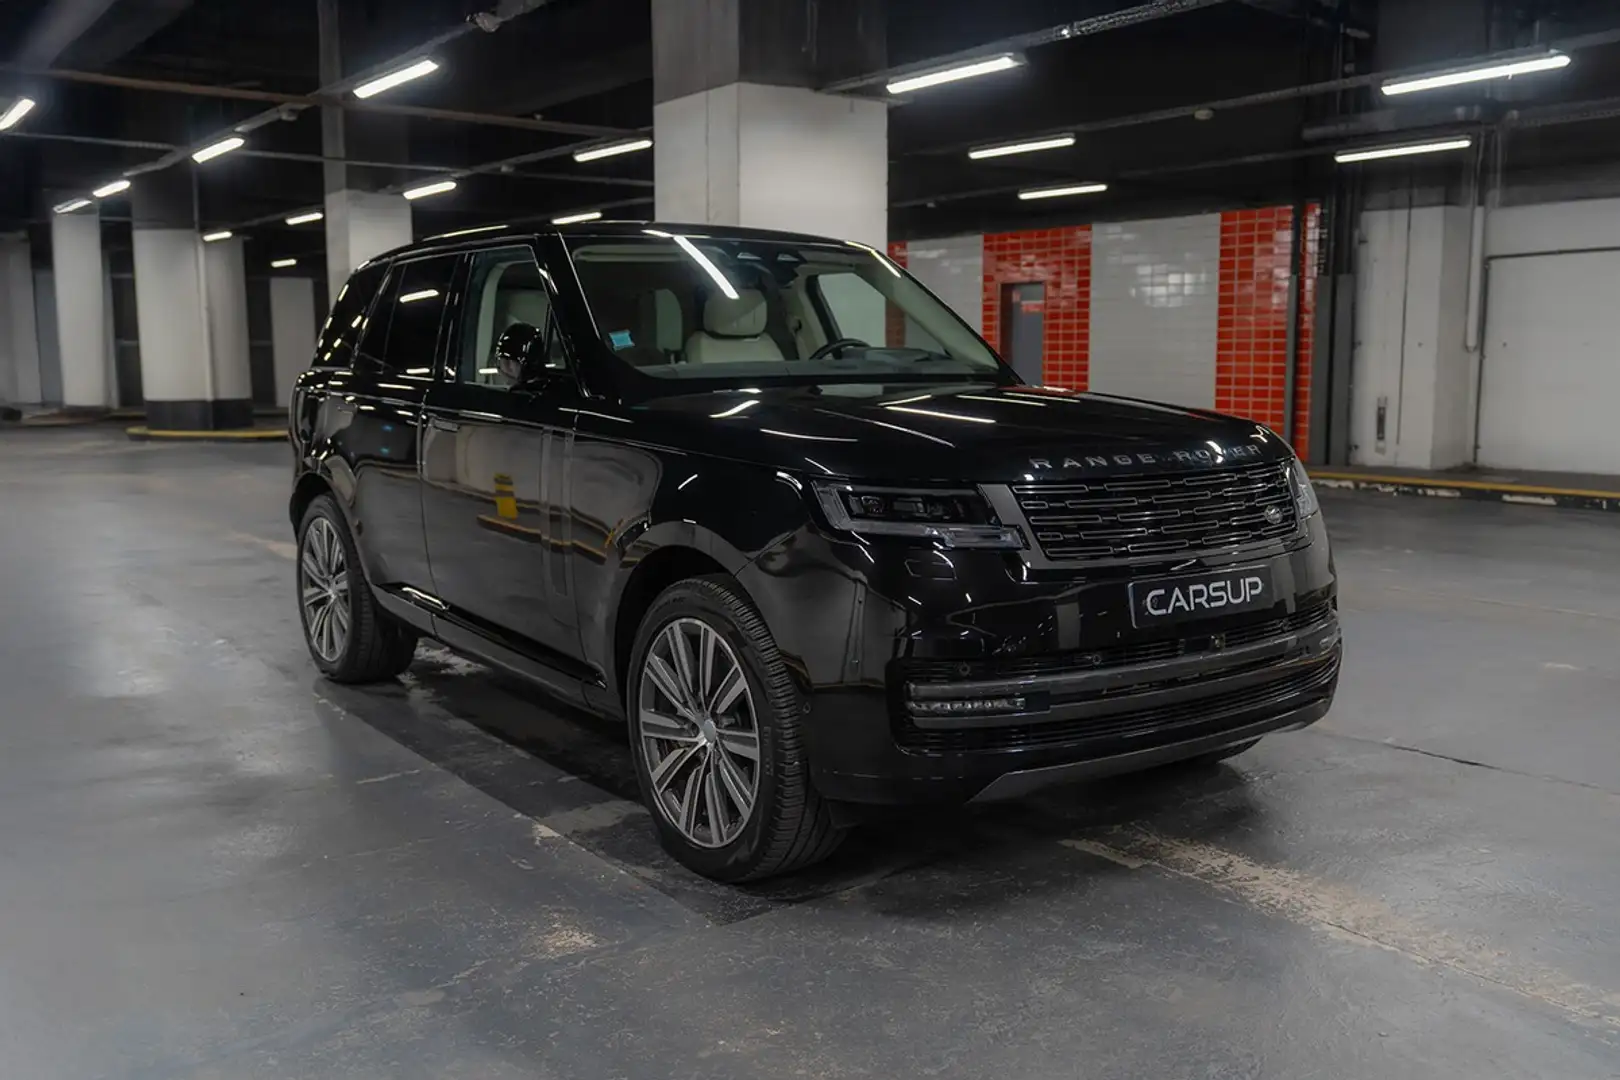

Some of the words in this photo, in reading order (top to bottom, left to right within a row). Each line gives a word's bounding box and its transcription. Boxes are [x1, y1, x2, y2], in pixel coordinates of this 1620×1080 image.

[1029, 454, 1156, 469] RANGE
[1172, 444, 1263, 463] ROER
[1146, 577, 1262, 615] CARSUP
